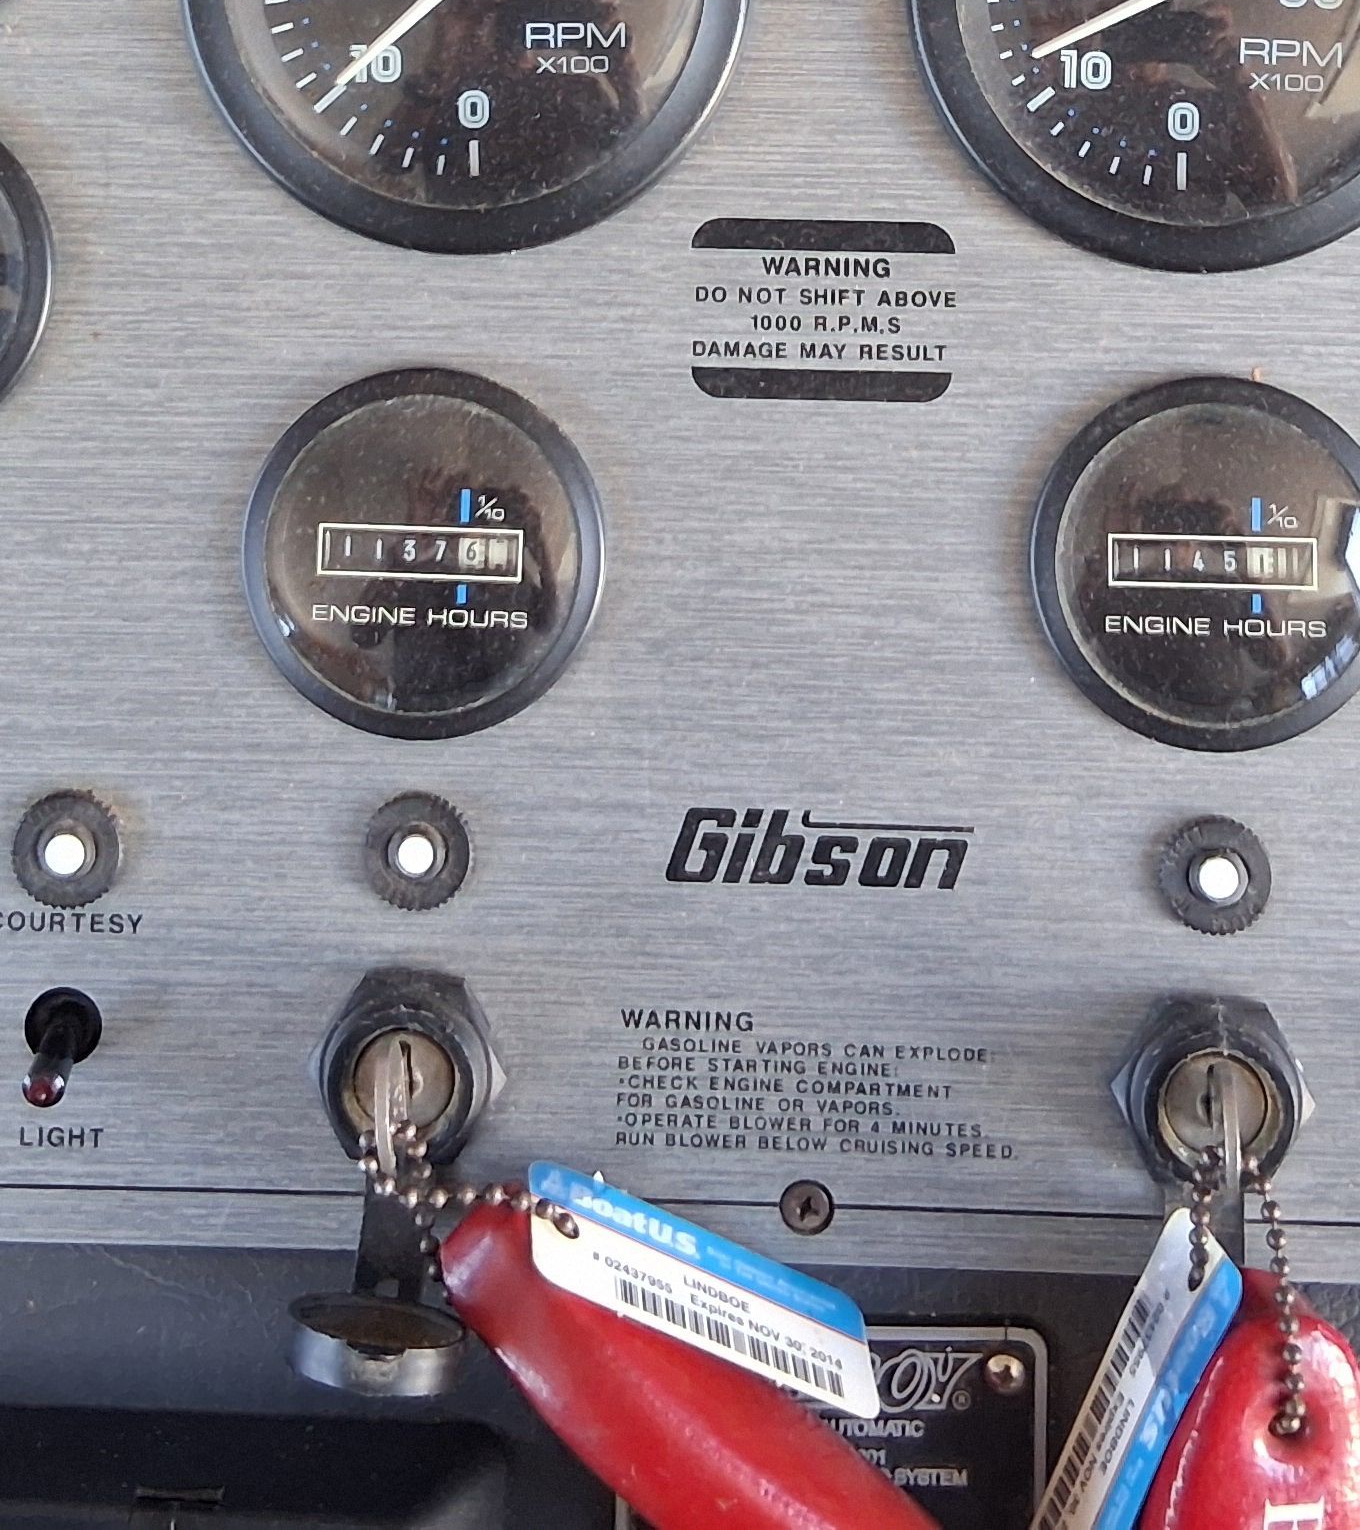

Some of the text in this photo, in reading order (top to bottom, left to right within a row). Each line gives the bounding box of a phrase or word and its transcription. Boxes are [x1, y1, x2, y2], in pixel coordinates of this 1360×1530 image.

[525, 22, 626, 49] RPM
[1239, 37, 1343, 68] RPM
[535, 55, 610, 74] X100
[1060, 49, 1113, 91] 10
[1250, 72, 1325, 93] X100
[457, 88, 490, 130] 0
[1166, 101, 1200, 142] 0
[761, 256, 891, 278] WARNING
[695, 286, 957, 308] DO NOT SHIFT ABOVE
[750, 315, 802, 331] 1000
[692, 341, 947, 361] DAMAGE MAY RESULT
[311, 604, 528, 630] ENGINE HOURS
[1105, 615, 1328, 639] ENGINE HOURS
[665, 807, 975, 890] Gibson
[621, 1009, 755, 1032] WARNING
[642, 1037, 885, 1059] GASOLINE VAPORS CAN
[618, 1056, 806, 1075] BEFORE STARTING
[709, 1077, 953, 1100] ENGINE COMPARTMENT
[616, 1092, 653, 1108] FOR
[665, 1094, 766, 1112] GASOLINE
[778, 1098, 804, 1113] OR
[729, 1116, 880, 1134] BLOWER FOR 4
[19, 1126, 105, 1148] LIGHT
[616, 1131, 934, 1157] RUN BLOWER BELOW CRUISING
[683, 1275, 751, 1314] LINDBOE
[691, 1293, 745, 1328] Expires
[749, 1321, 780, 1342] NOV
